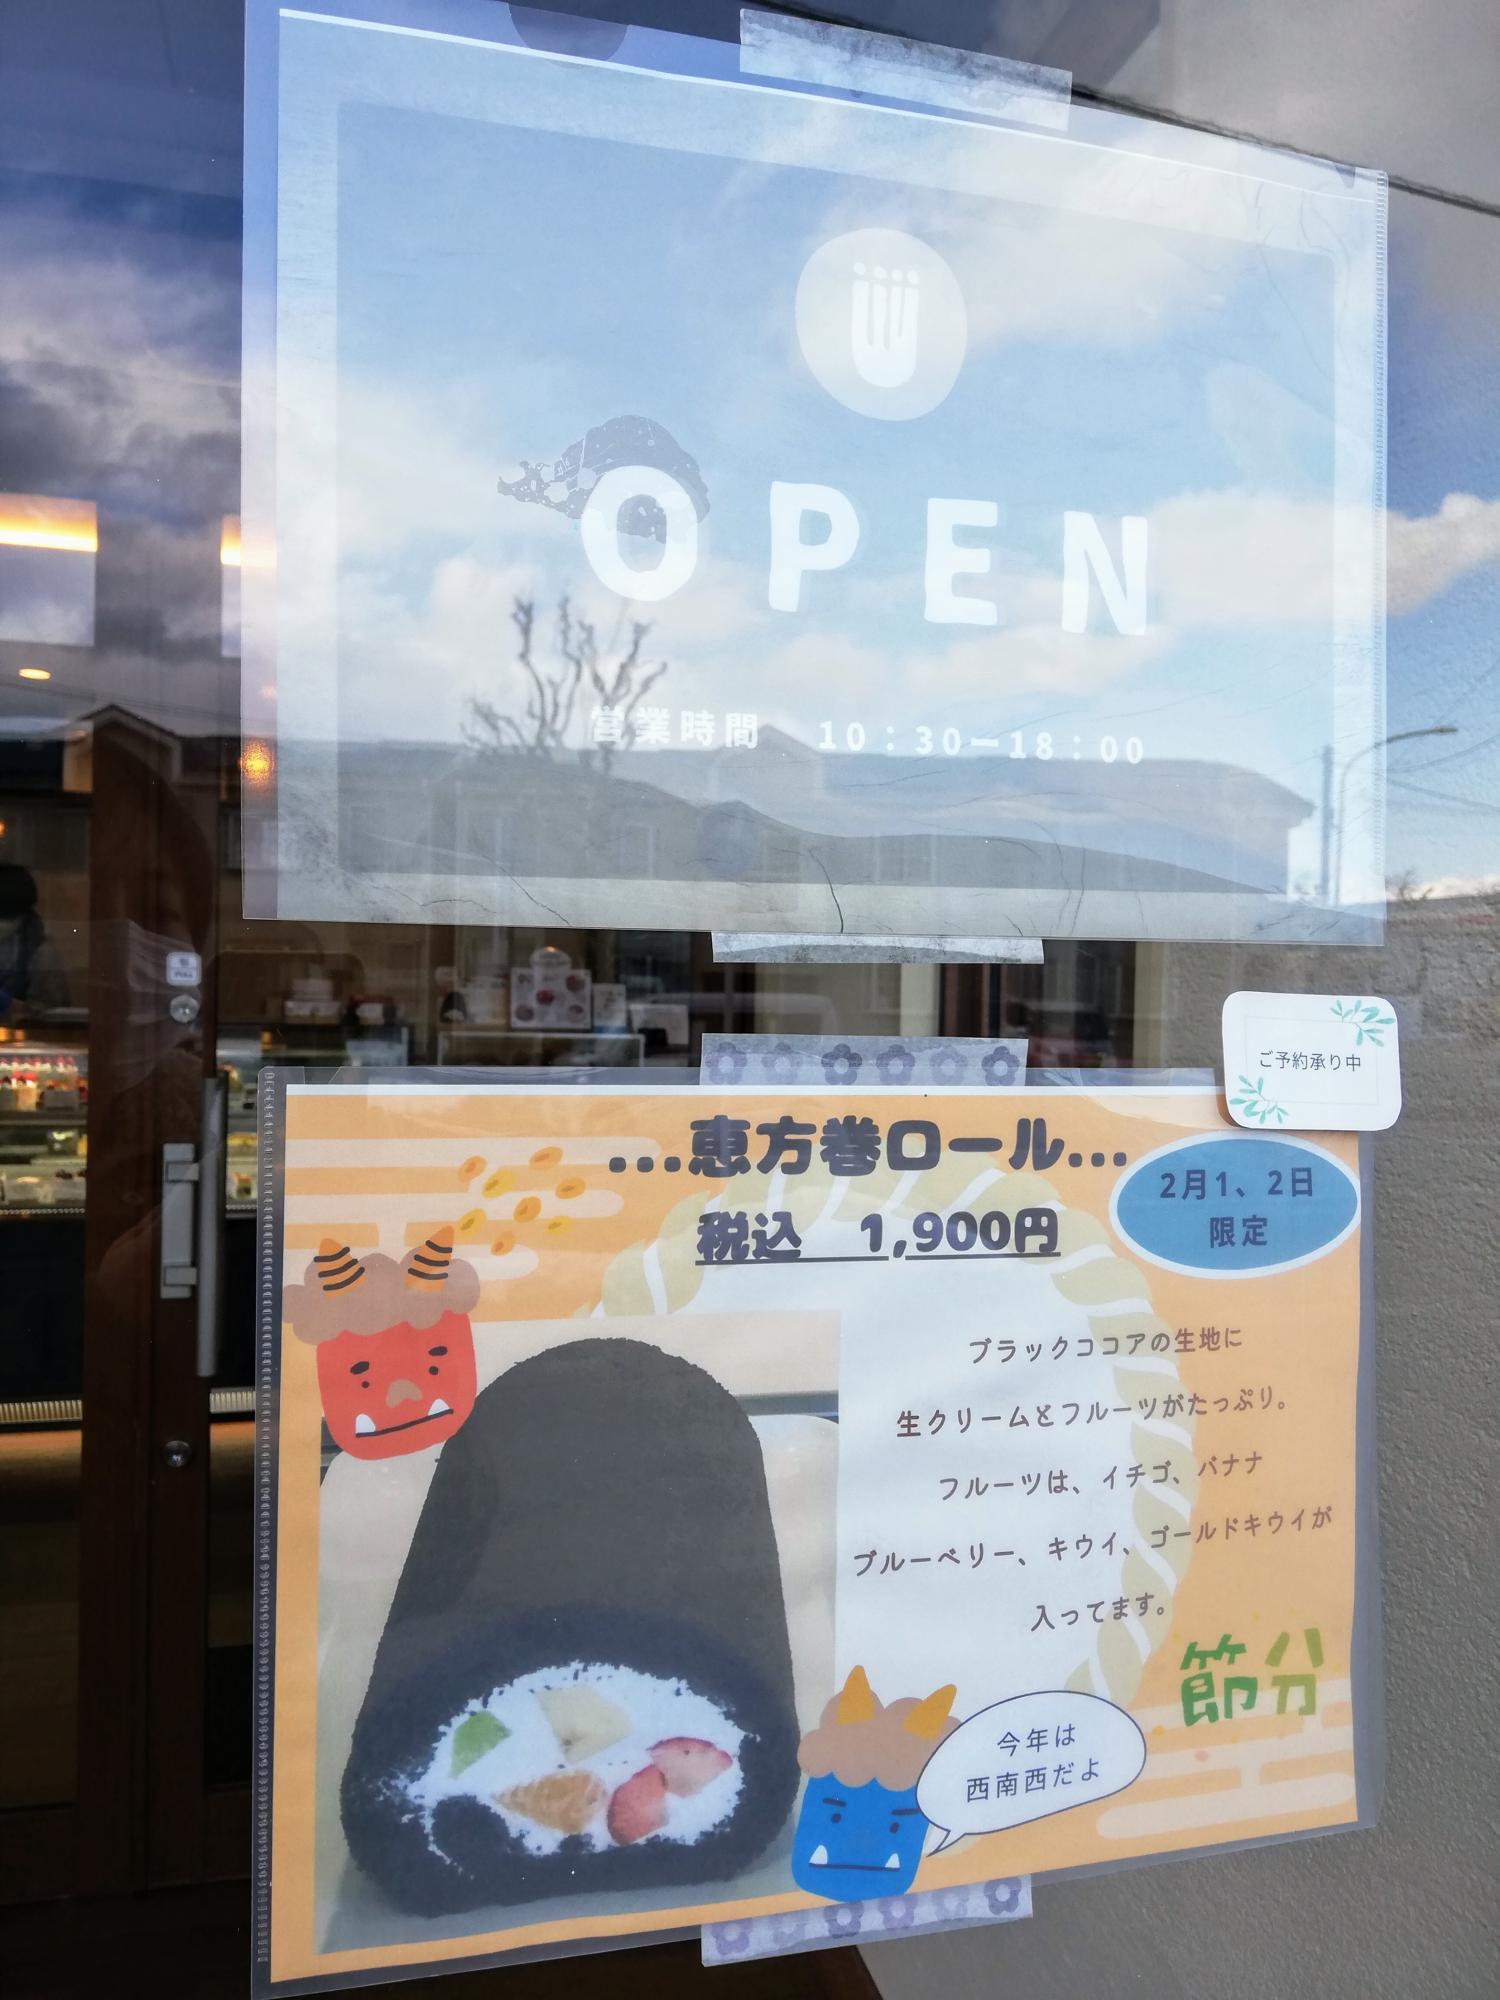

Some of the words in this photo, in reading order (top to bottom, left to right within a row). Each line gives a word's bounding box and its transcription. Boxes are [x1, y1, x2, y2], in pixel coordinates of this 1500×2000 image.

[581, 465, 1148, 636] OPEN
[591, 706, 759, 750] 営業時間
[1259, 1050, 1361, 1072] ご予約承り中
[1160, 1167, 1313, 1201] 2月1、2日
[697, 1211, 802, 1260] 税込
[860, 1208, 1060, 1259] 1,900円
[1209, 1214, 1268, 1249] 限定
[969, 1326, 1243, 1364] ブラックココアの生地に
[896, 1385, 1287, 1438] 生クリームとフルーツがたっぷり。
[938, 1450, 1263, 1501] フルーツは、イチゴ、バナナ
[853, 1505, 1333, 1577] ブルーベリー、キウイ、ゴールドキウイが
[1030, 1591, 1167, 1632] 入ってます。
[1179, 1626, 1325, 1728] 節分
[996, 1723, 1077, 1757] 今年は
[965, 1757, 1101, 1803] 西南西だよ
